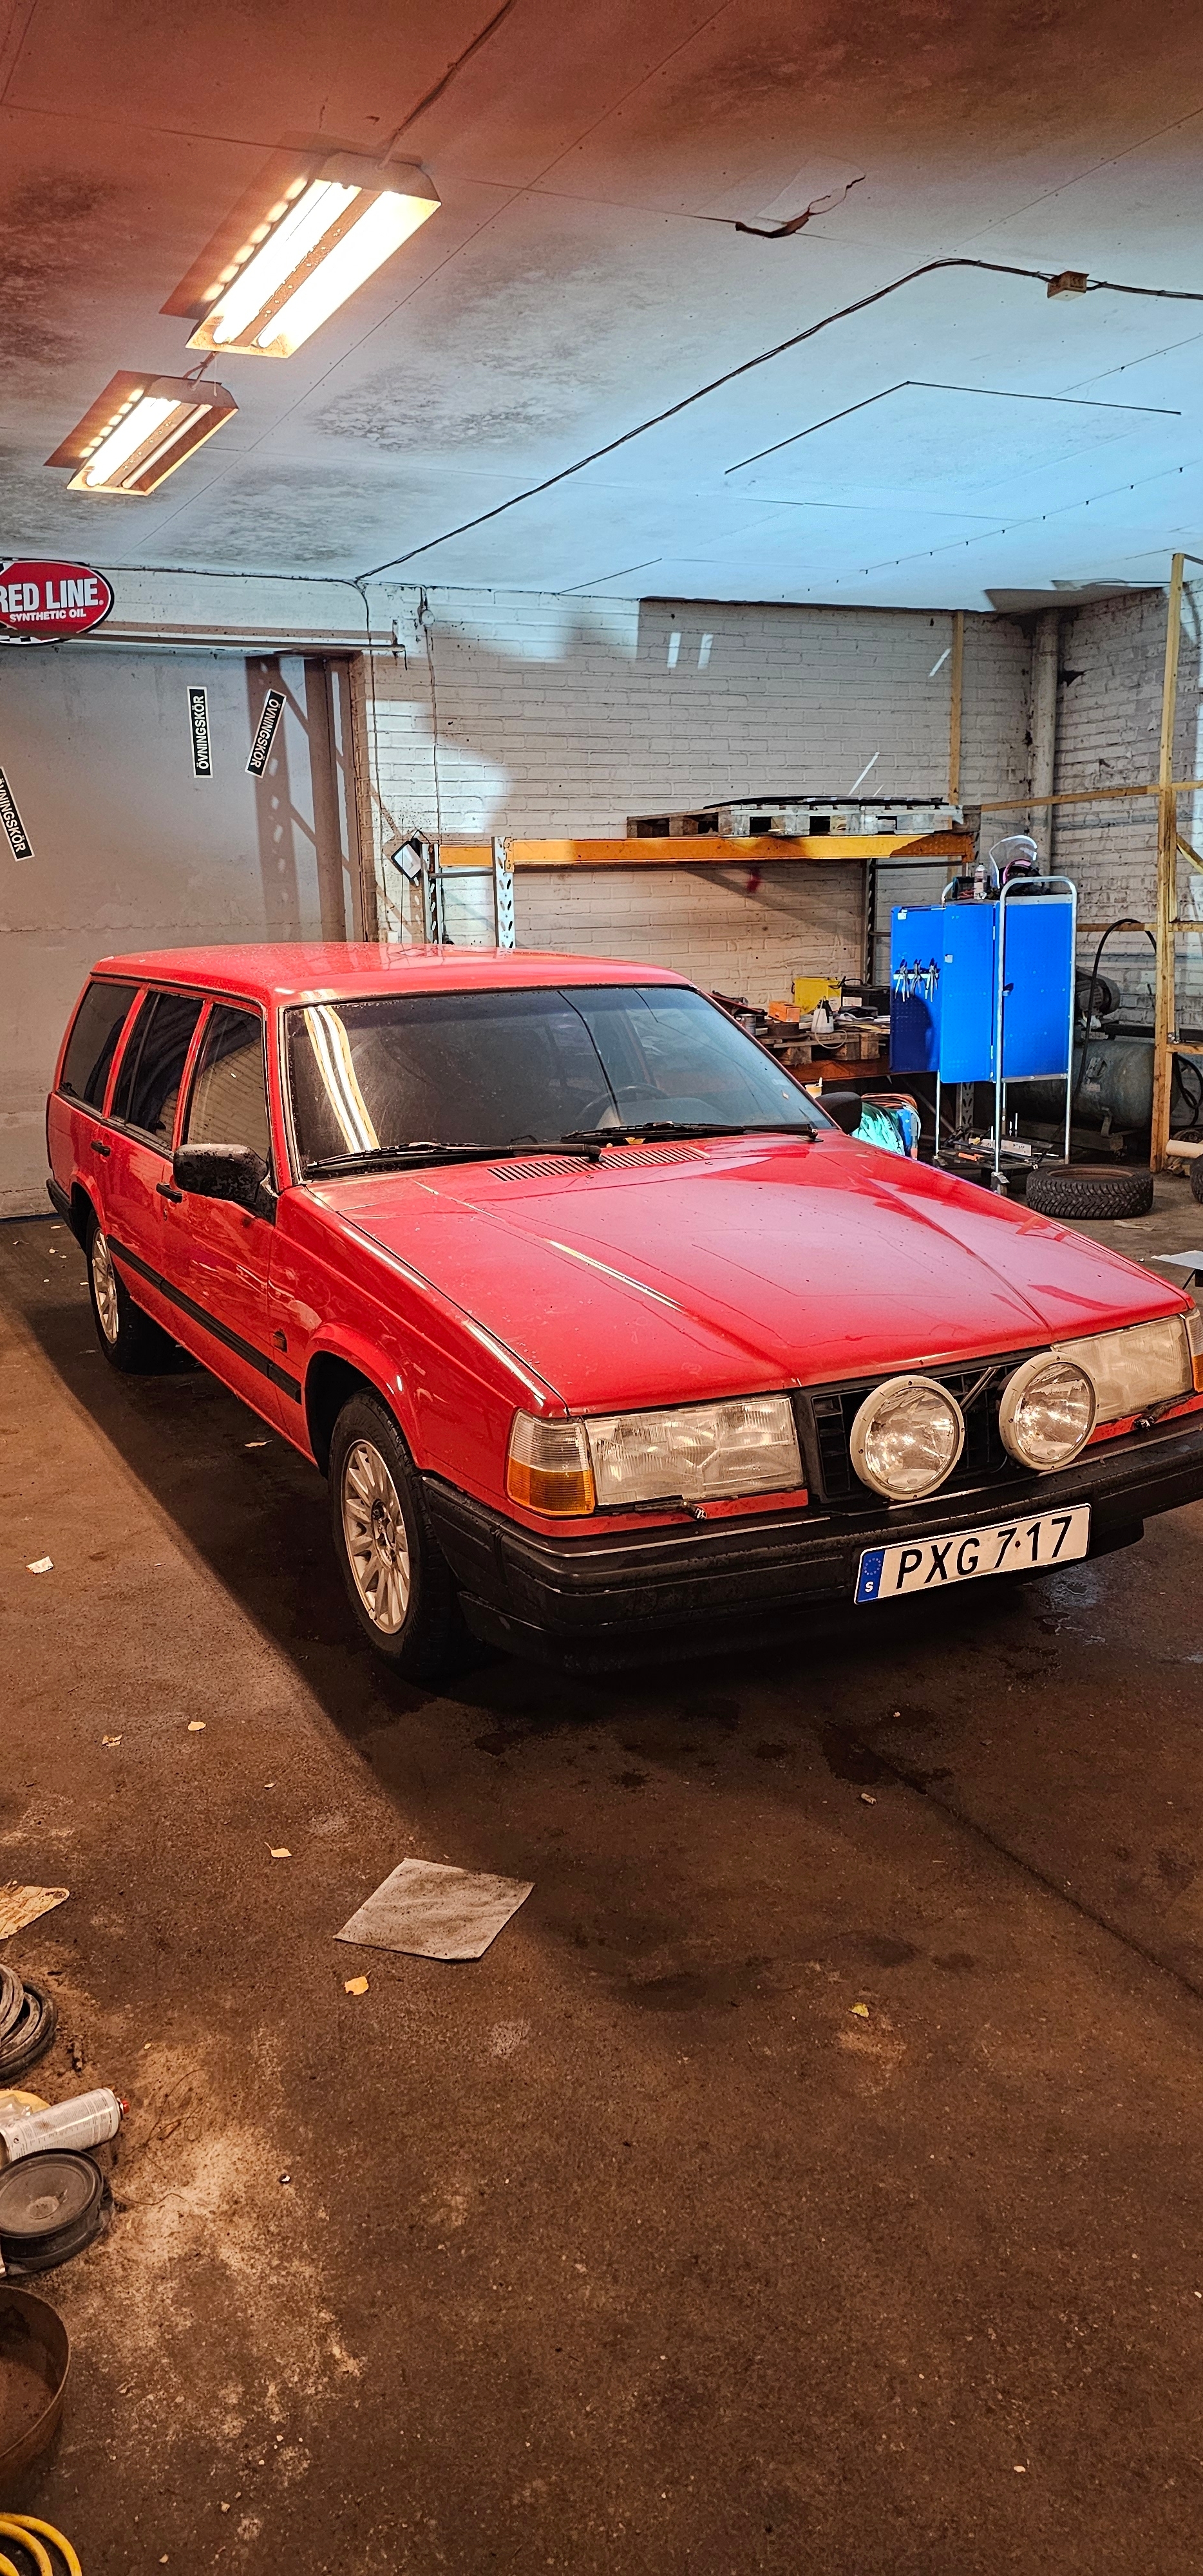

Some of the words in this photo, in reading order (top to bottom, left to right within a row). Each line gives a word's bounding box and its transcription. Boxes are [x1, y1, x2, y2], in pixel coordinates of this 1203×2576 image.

[10, 611, 66, 623] SYNTHETIC
[69, 609, 87, 618] OIL
[46, 578, 99, 609] LINE
[192, 696, 209, 770] ÖVNINGSKÖR
[251, 699, 281, 768] ÖVNINGSKÖR
[896, 1537, 980, 1589] PXG
[993, 1515, 1072, 1569] 717
[865, 1581, 874, 1593] S
